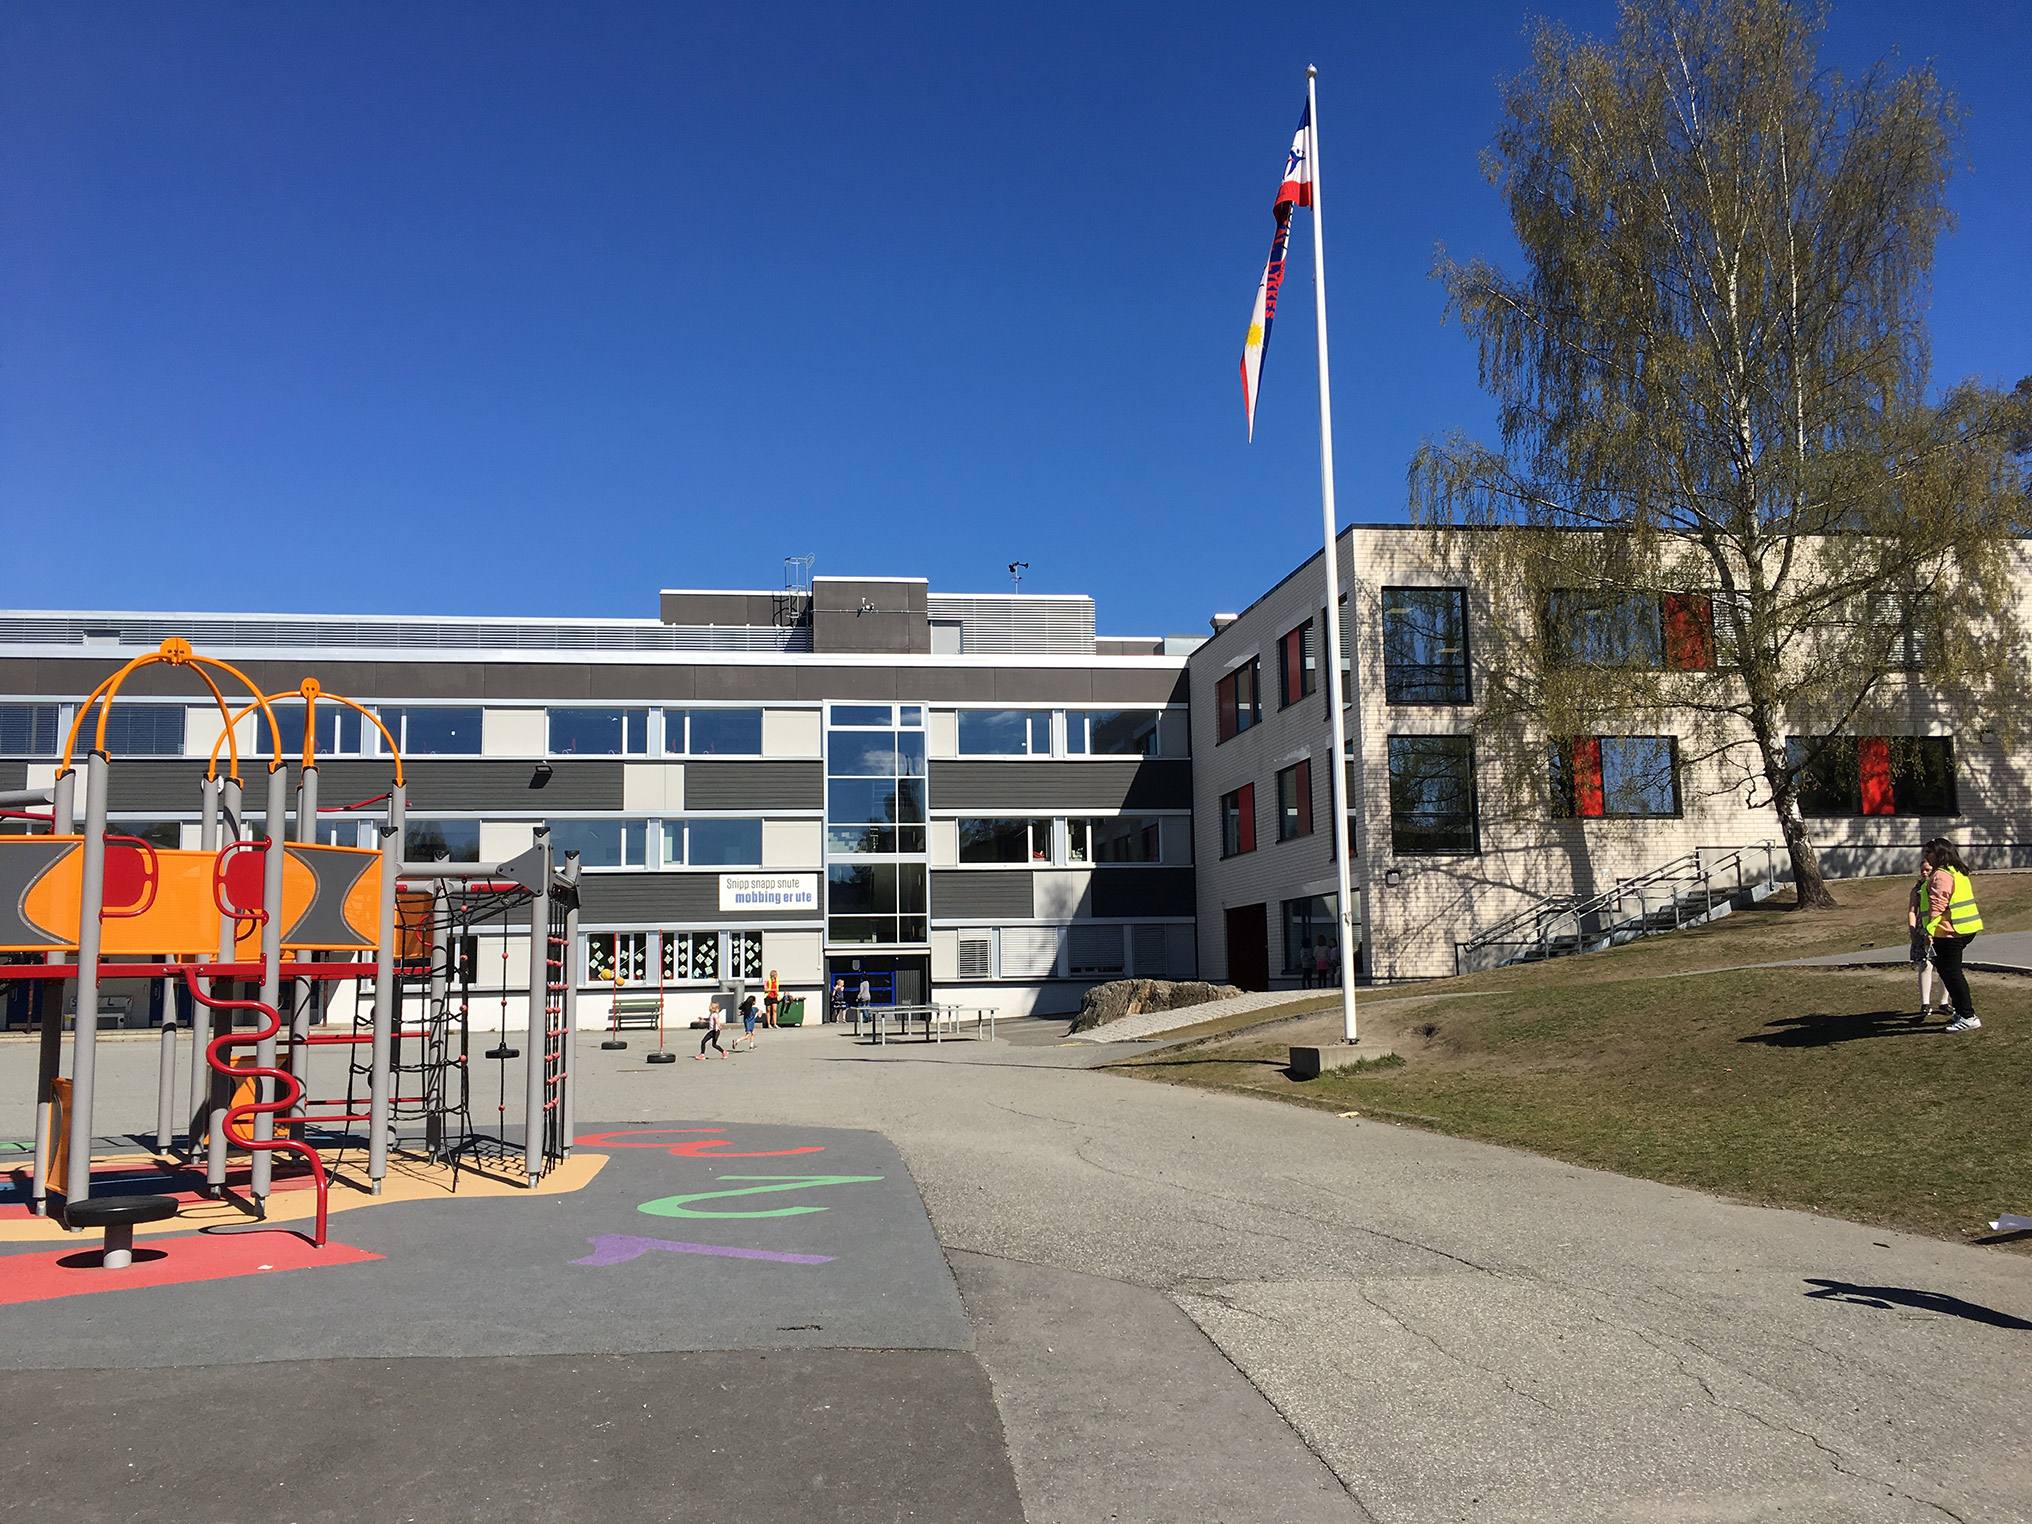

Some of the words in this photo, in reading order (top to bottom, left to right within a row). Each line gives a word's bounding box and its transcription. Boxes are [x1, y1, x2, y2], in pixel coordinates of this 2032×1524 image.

[1265, 261, 1282, 320] LYKKES
[726, 878, 749, 890] Snipp
[751, 880, 775, 890] snapp
[777, 879, 800, 889] snute
[735, 891, 781, 904] mobbing
[783, 893, 793, 903] er
[796, 892, 812, 902] ute
